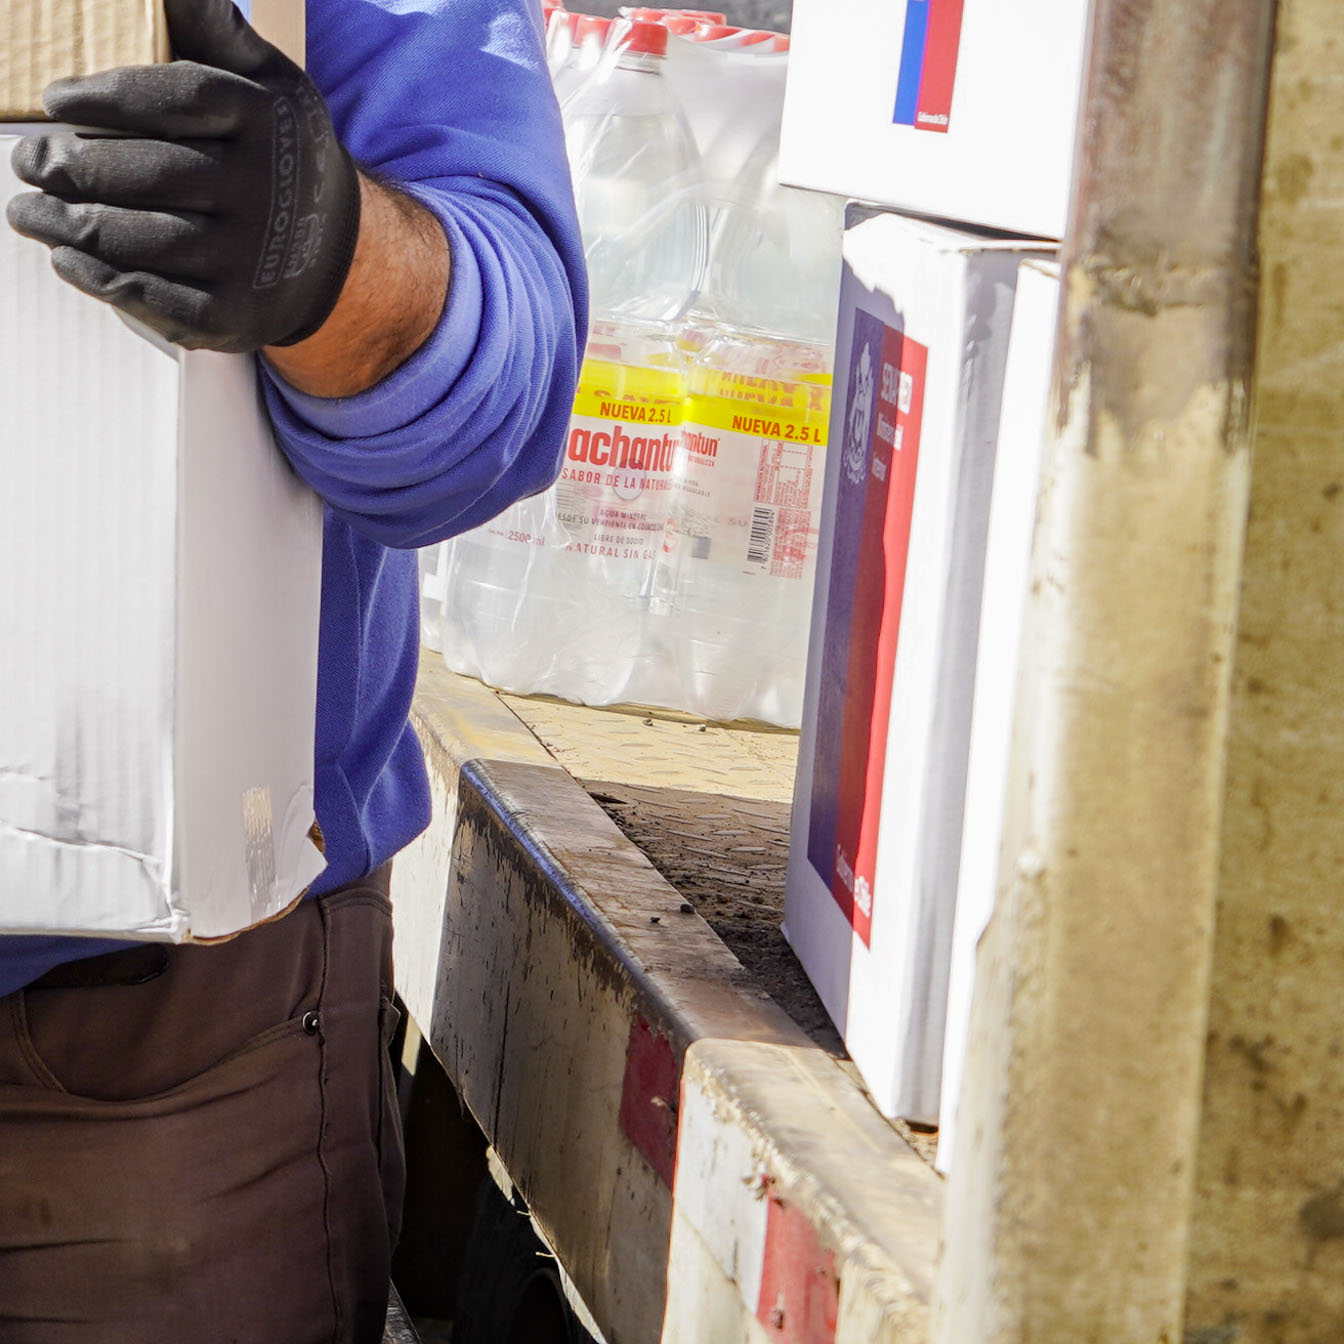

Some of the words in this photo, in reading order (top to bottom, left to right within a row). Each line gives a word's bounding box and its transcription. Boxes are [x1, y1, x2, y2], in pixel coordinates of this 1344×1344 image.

[600, 402, 646, 422] NUEVA
[648, 407, 665, 424] 2.5
[667, 409, 672, 424] L
[732, 415, 781, 437] NUEVA
[784, 424, 810, 441] 2.5
[813, 428, 821, 443] L
[561, 468, 601, 485] SABOR
[605, 473, 619, 487] DE
[624, 475, 636, 489] LA
